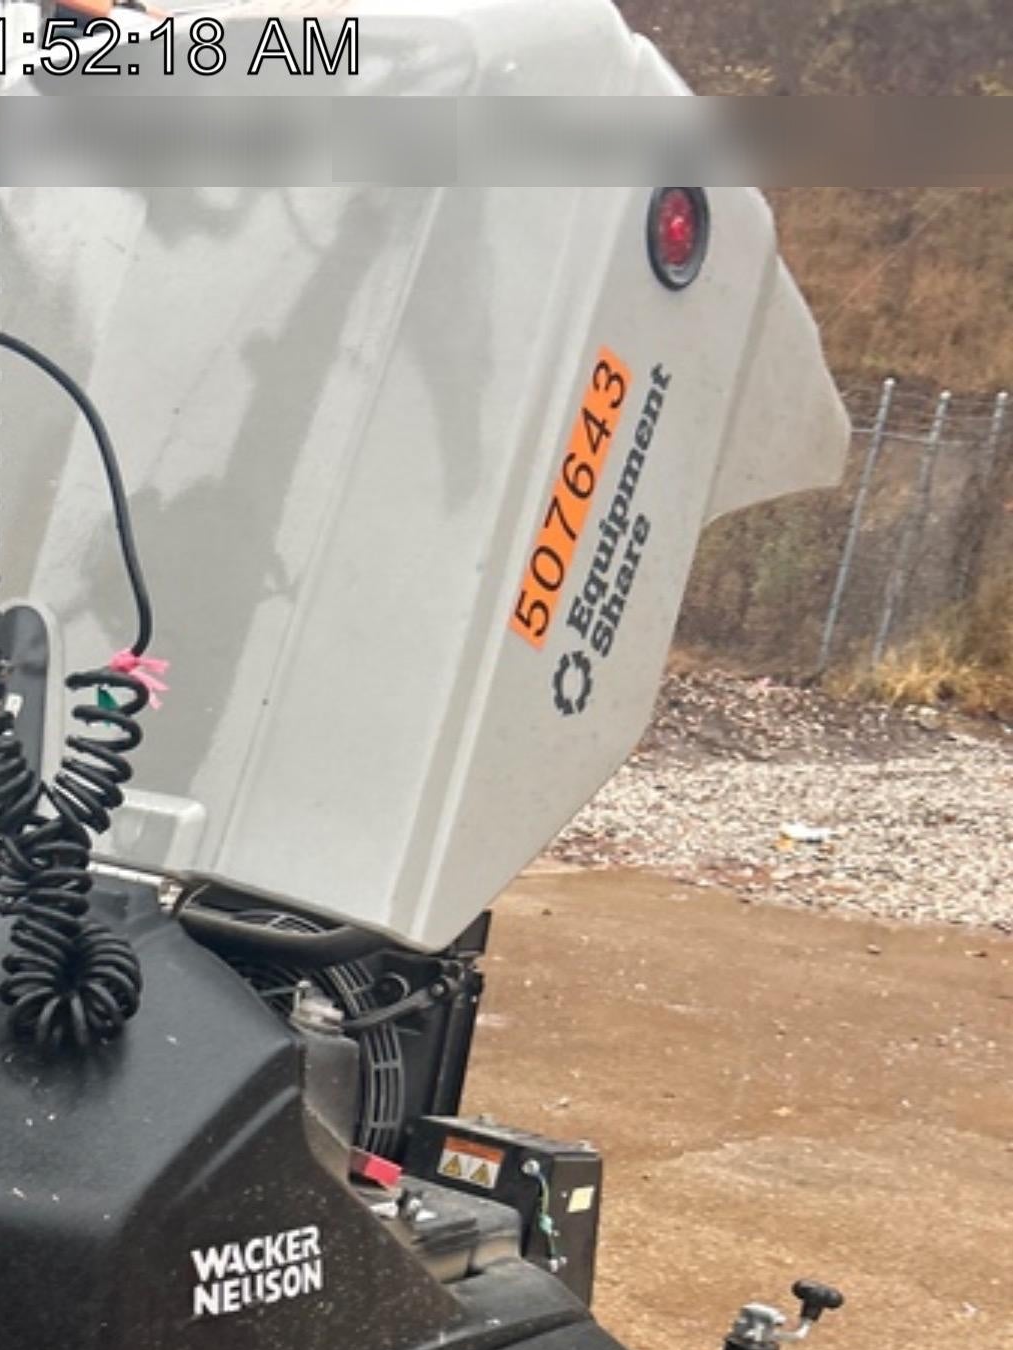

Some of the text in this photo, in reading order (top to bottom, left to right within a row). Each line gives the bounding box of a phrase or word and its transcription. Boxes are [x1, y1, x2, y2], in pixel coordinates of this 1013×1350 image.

[514, 359, 626, 638] 507643
[567, 363, 672, 638] Equipment
[590, 514, 651, 657] Share
[191, 1226, 322, 1281] WACKER
[193, 1259, 324, 1316] NEUSON
